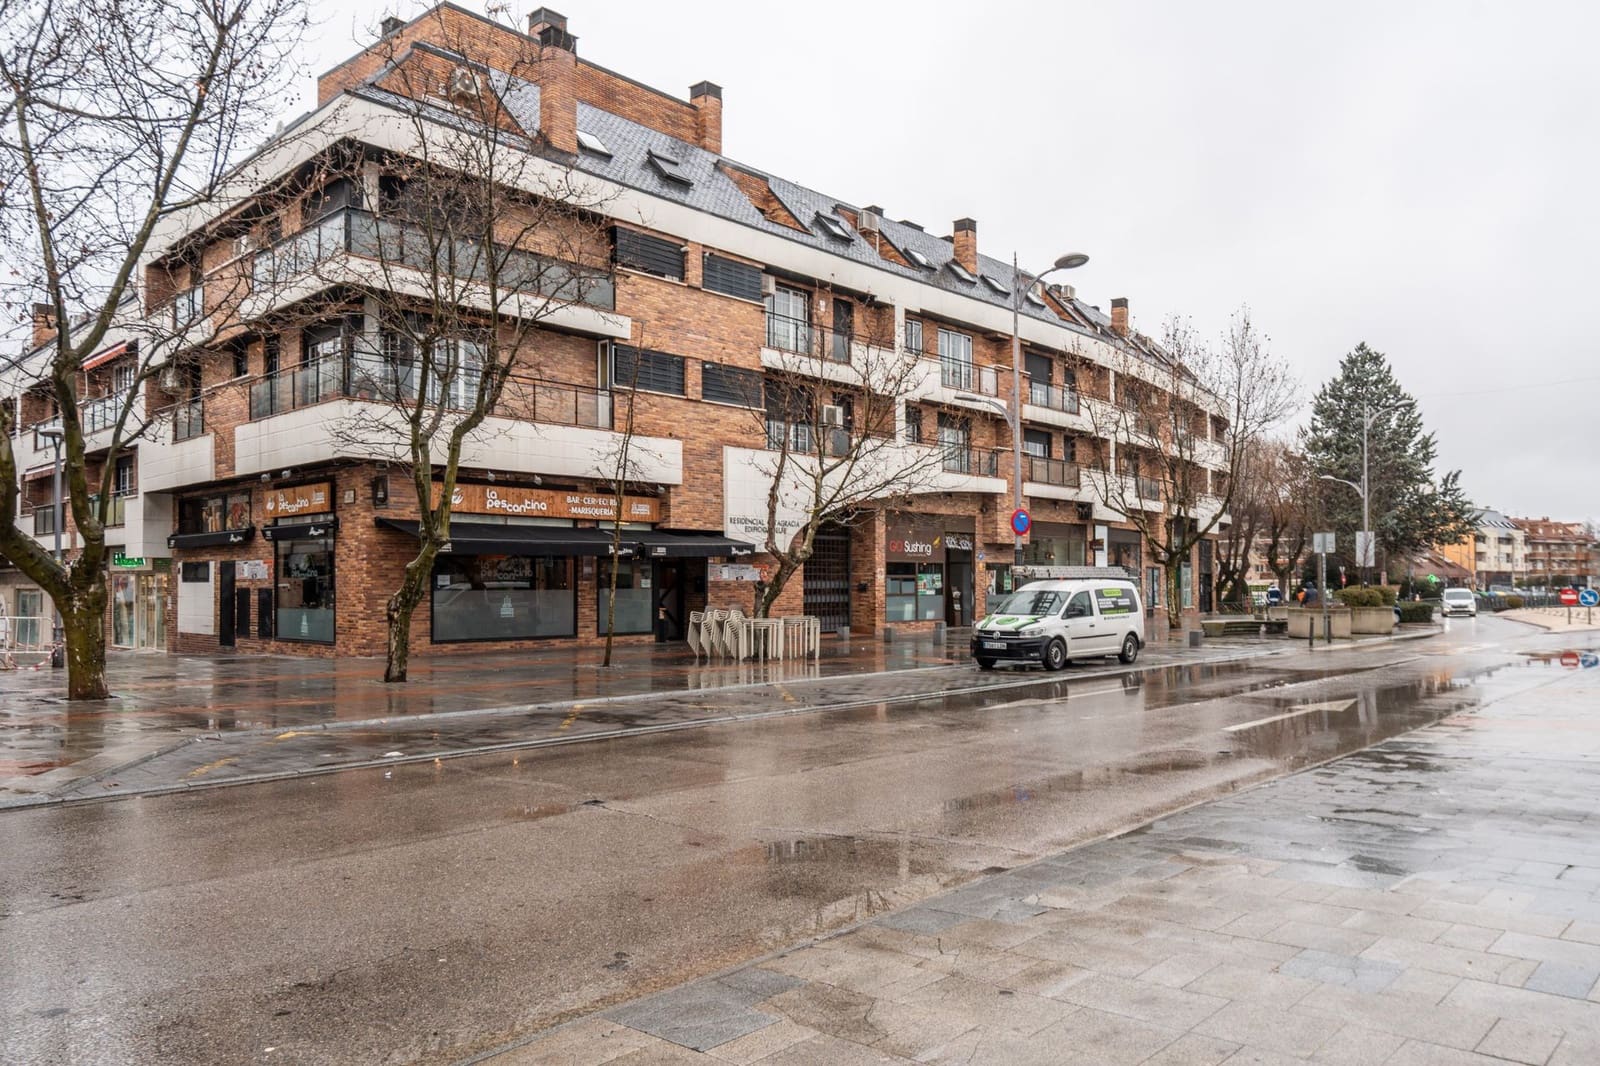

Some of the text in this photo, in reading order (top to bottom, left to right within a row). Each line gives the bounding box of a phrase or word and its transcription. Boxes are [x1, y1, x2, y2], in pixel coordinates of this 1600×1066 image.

[487, 488, 497, 499] la
[487, 499, 547, 512] pescantina
[566, 496, 580, 504] BAR
[729, 517, 765, 526] RESIDENCIAL
[904, 540, 932, 556] Sushing
